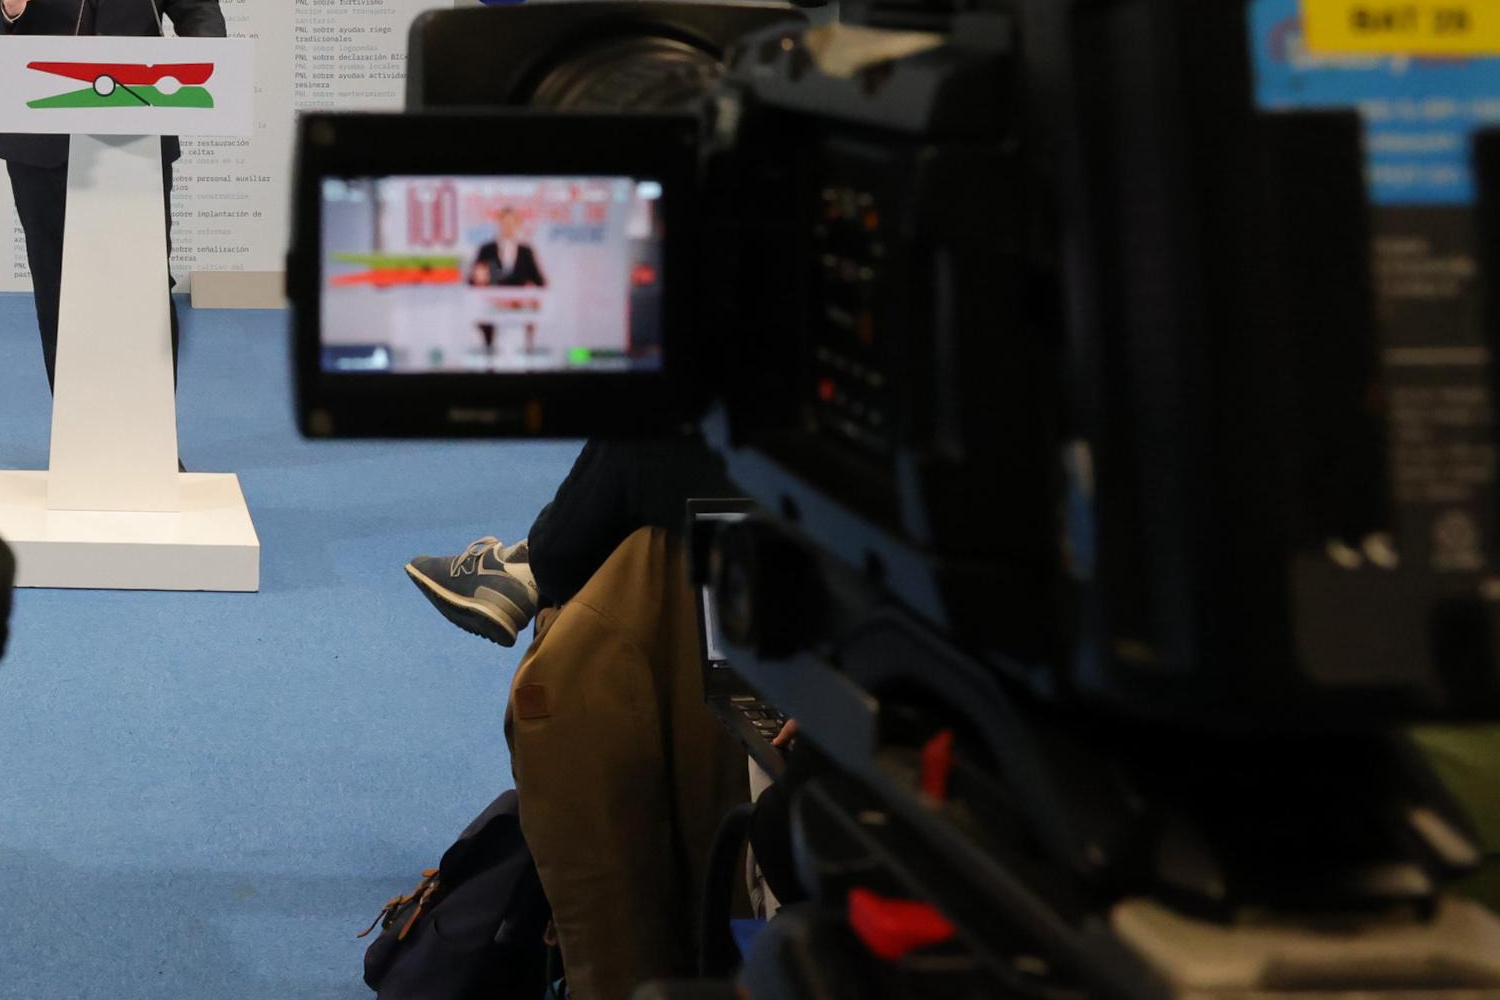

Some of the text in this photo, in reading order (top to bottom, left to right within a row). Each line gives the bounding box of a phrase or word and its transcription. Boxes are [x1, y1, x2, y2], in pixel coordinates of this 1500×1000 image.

[338, 26, 365, 34] ayudas
[369, 26, 392, 34] riego
[197, 175, 232, 184] personal
[171, 210, 193, 218] sobre
[197, 210, 249, 219] implantación
